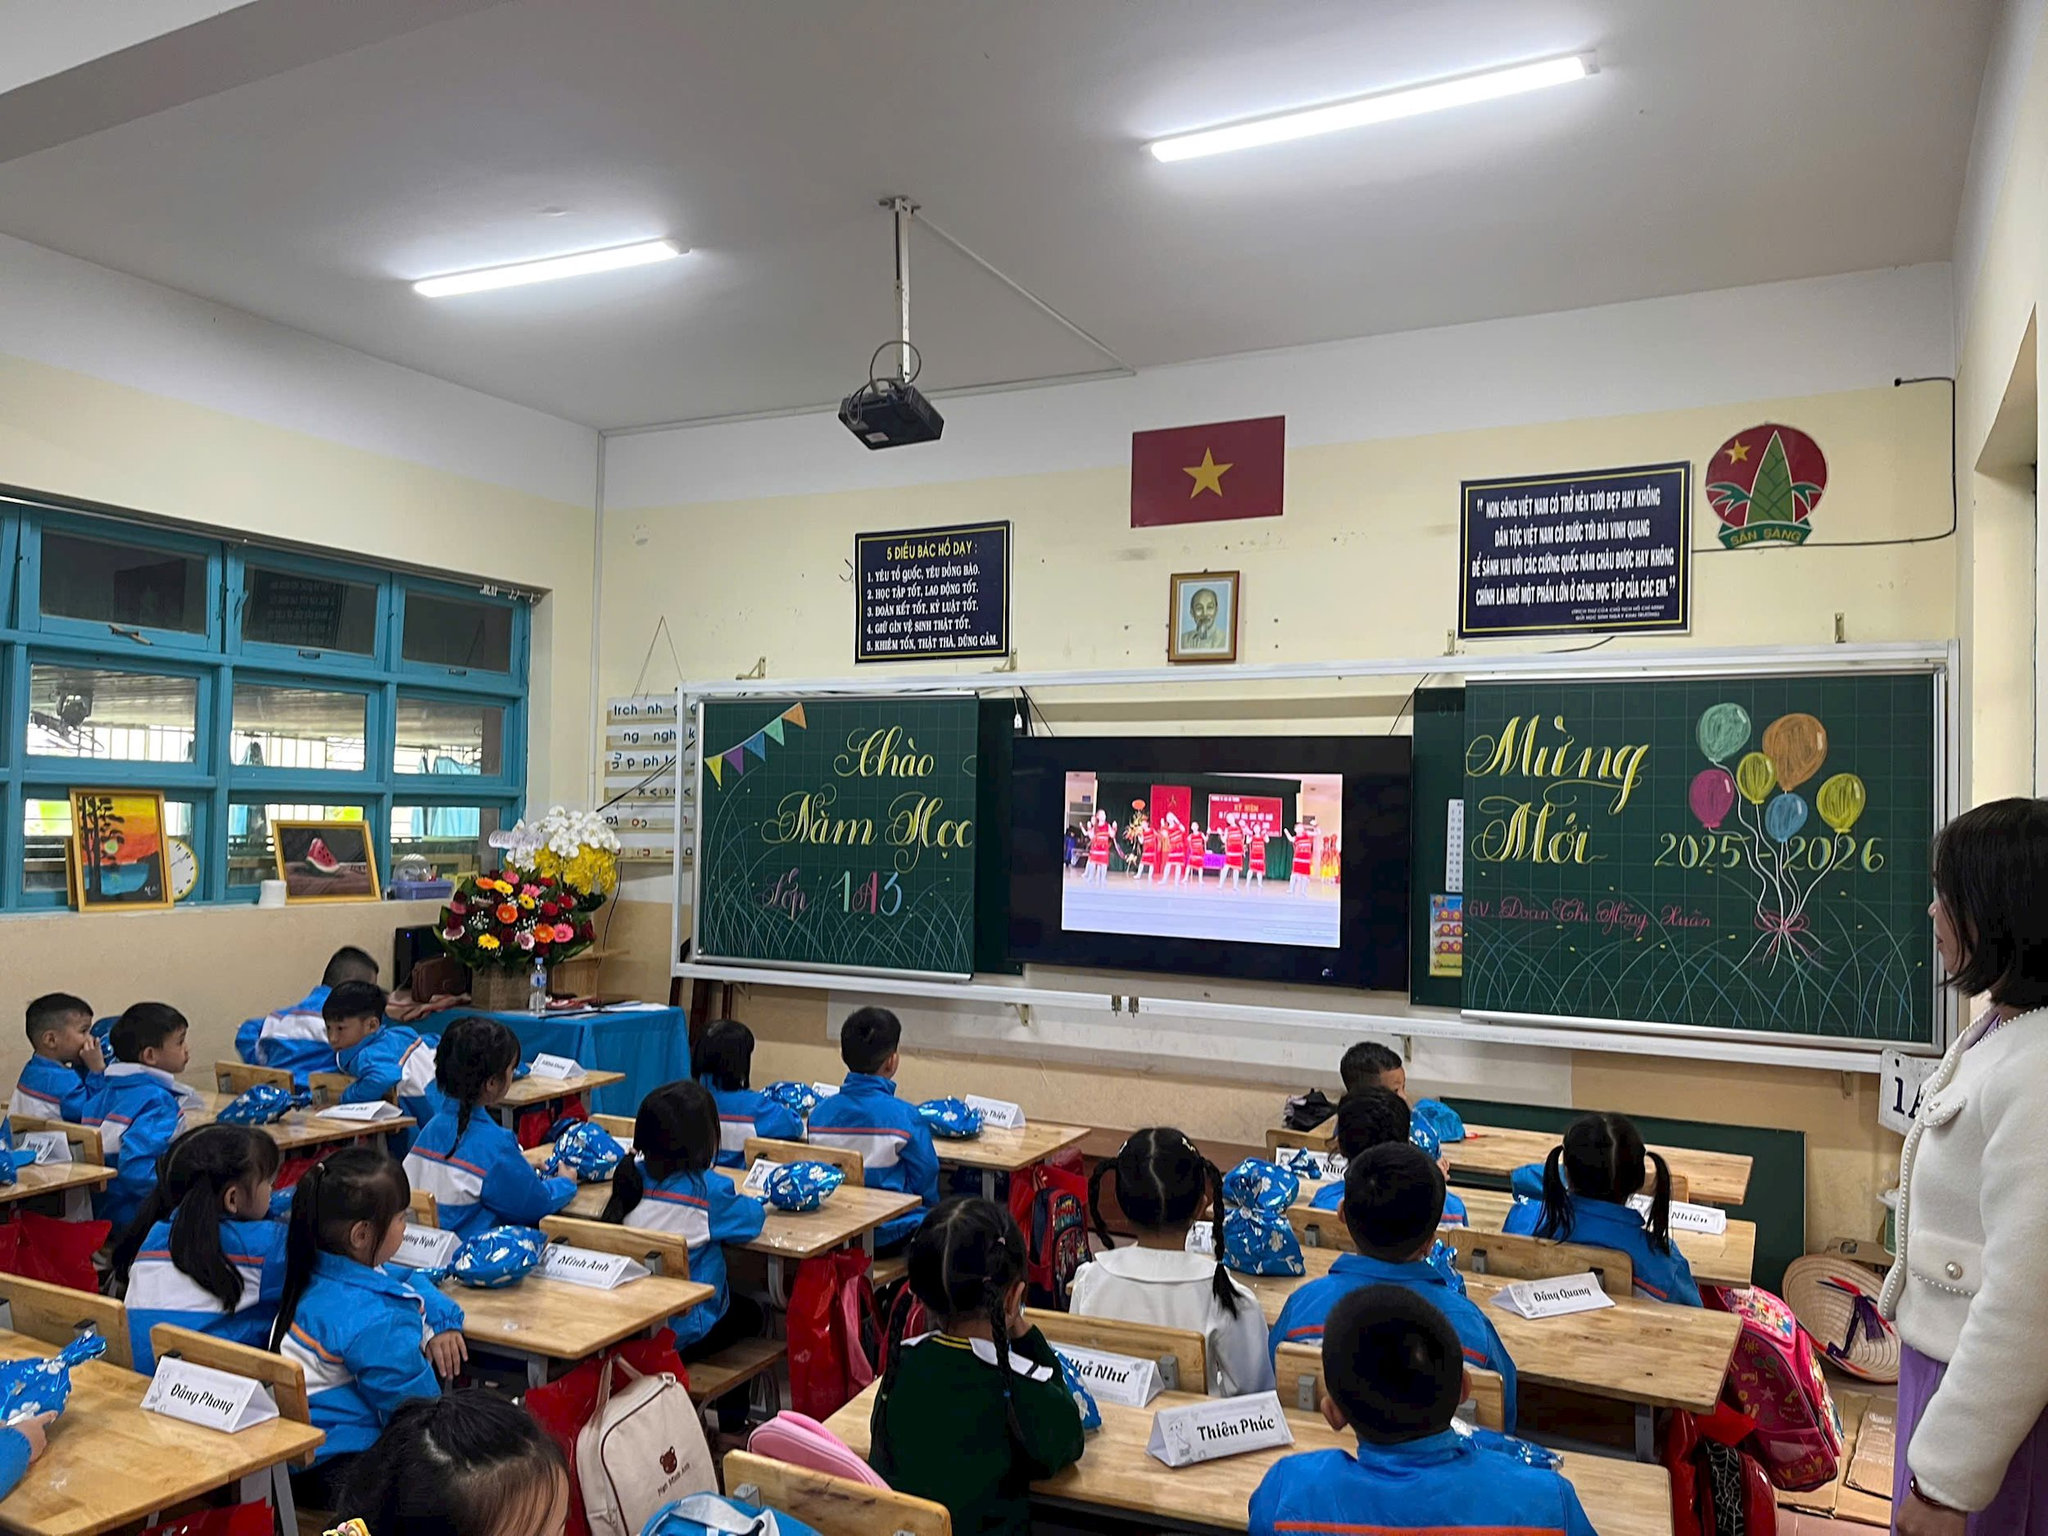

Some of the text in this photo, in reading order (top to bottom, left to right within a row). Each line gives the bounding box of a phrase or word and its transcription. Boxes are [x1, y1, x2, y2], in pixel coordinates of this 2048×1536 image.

[887, 547, 892, 560] 5
[895, 540, 915, 560] ĐIỀU
[918, 543, 935, 557] BÁC
[938, 537, 951, 556] HỒ
[954, 540, 972, 557] DẠY
[833, 725, 934, 777] Chào
[1465, 713, 1649, 815] Mừng
[761, 783, 974, 873] Năm Học
[1470, 795, 1608, 865] Mới
[1654, 832, 1745, 870] 2025
[1784, 835, 1884, 873] 2026
[754, 867, 810, 922] Lớp
[558, 1256, 609, 1272] Minh Anh
[1560, 1287, 1592, 1299] Quang
[1068, 1358, 1129, 1383] hả Như
[200, 1392, 234, 1415] Phong
[1197, 1415, 1275, 1441] Thiên Phúc
